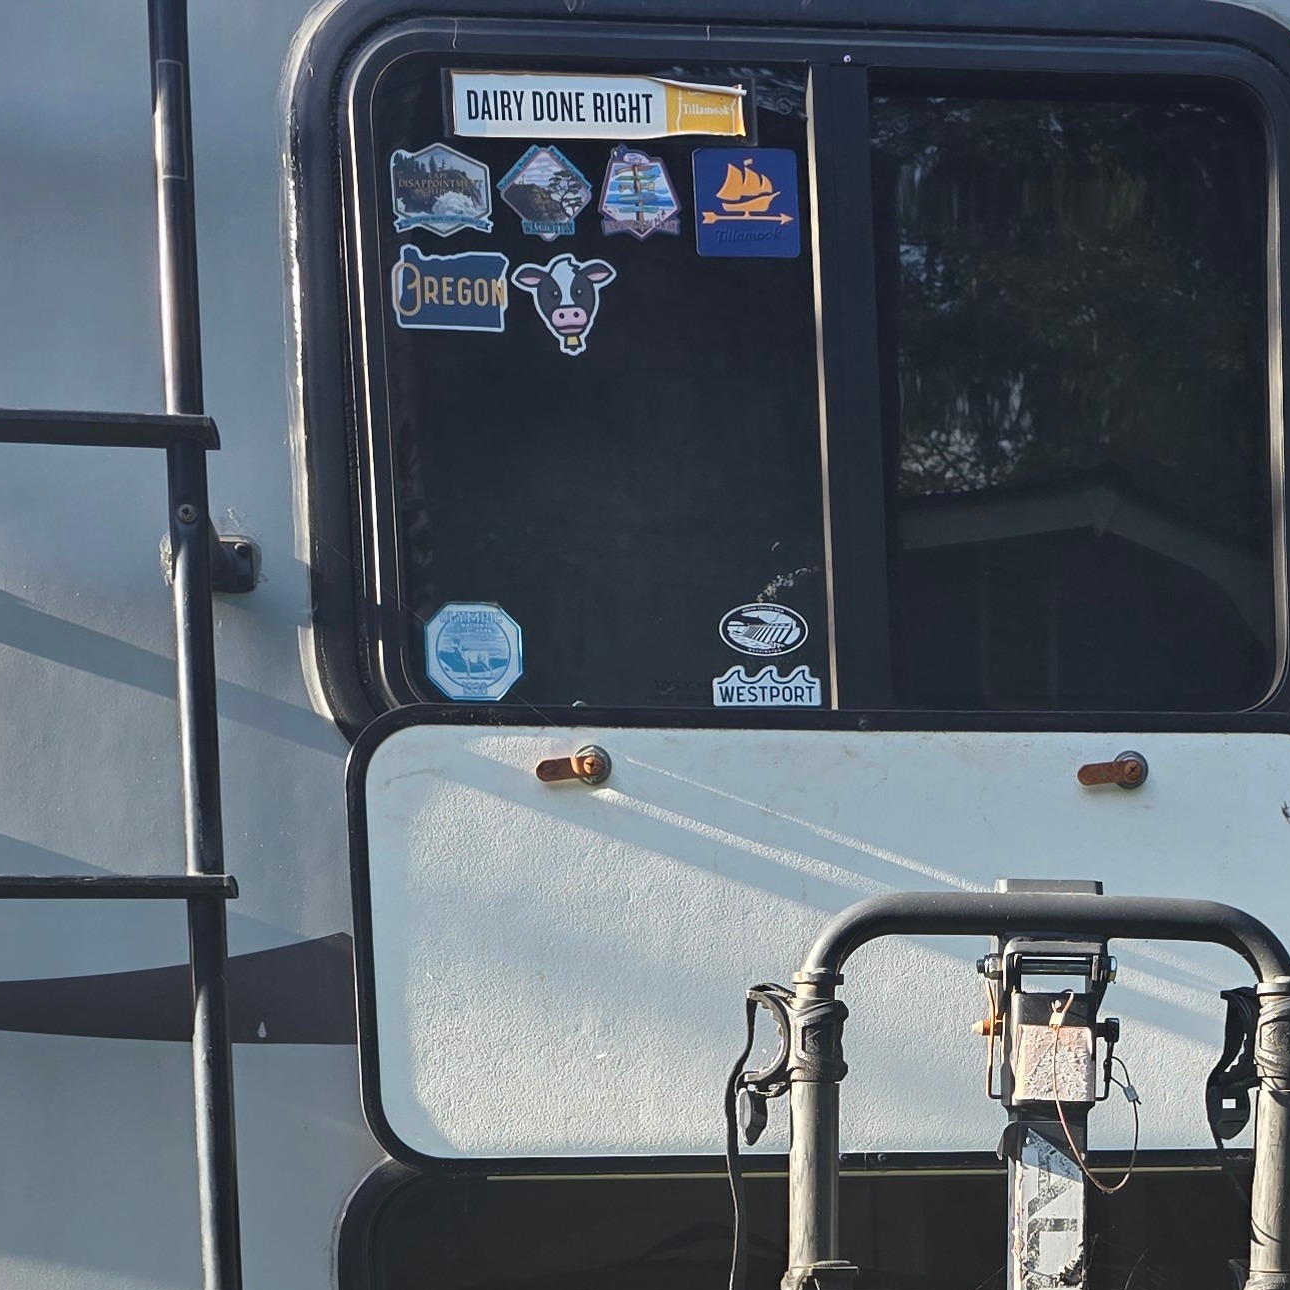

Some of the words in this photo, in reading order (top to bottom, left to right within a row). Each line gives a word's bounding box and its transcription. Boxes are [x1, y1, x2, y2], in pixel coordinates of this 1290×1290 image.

[466, 89, 525, 121] DAIRY
[532, 91, 586, 122] DONE
[592, 92, 653, 124] RIGHT
[714, 226, 783, 244] Tillamook
[391, 262, 506, 316] OREGON
[439, 611, 503, 624] OLYMPIC
[719, 685, 815, 703] WESTPORT
